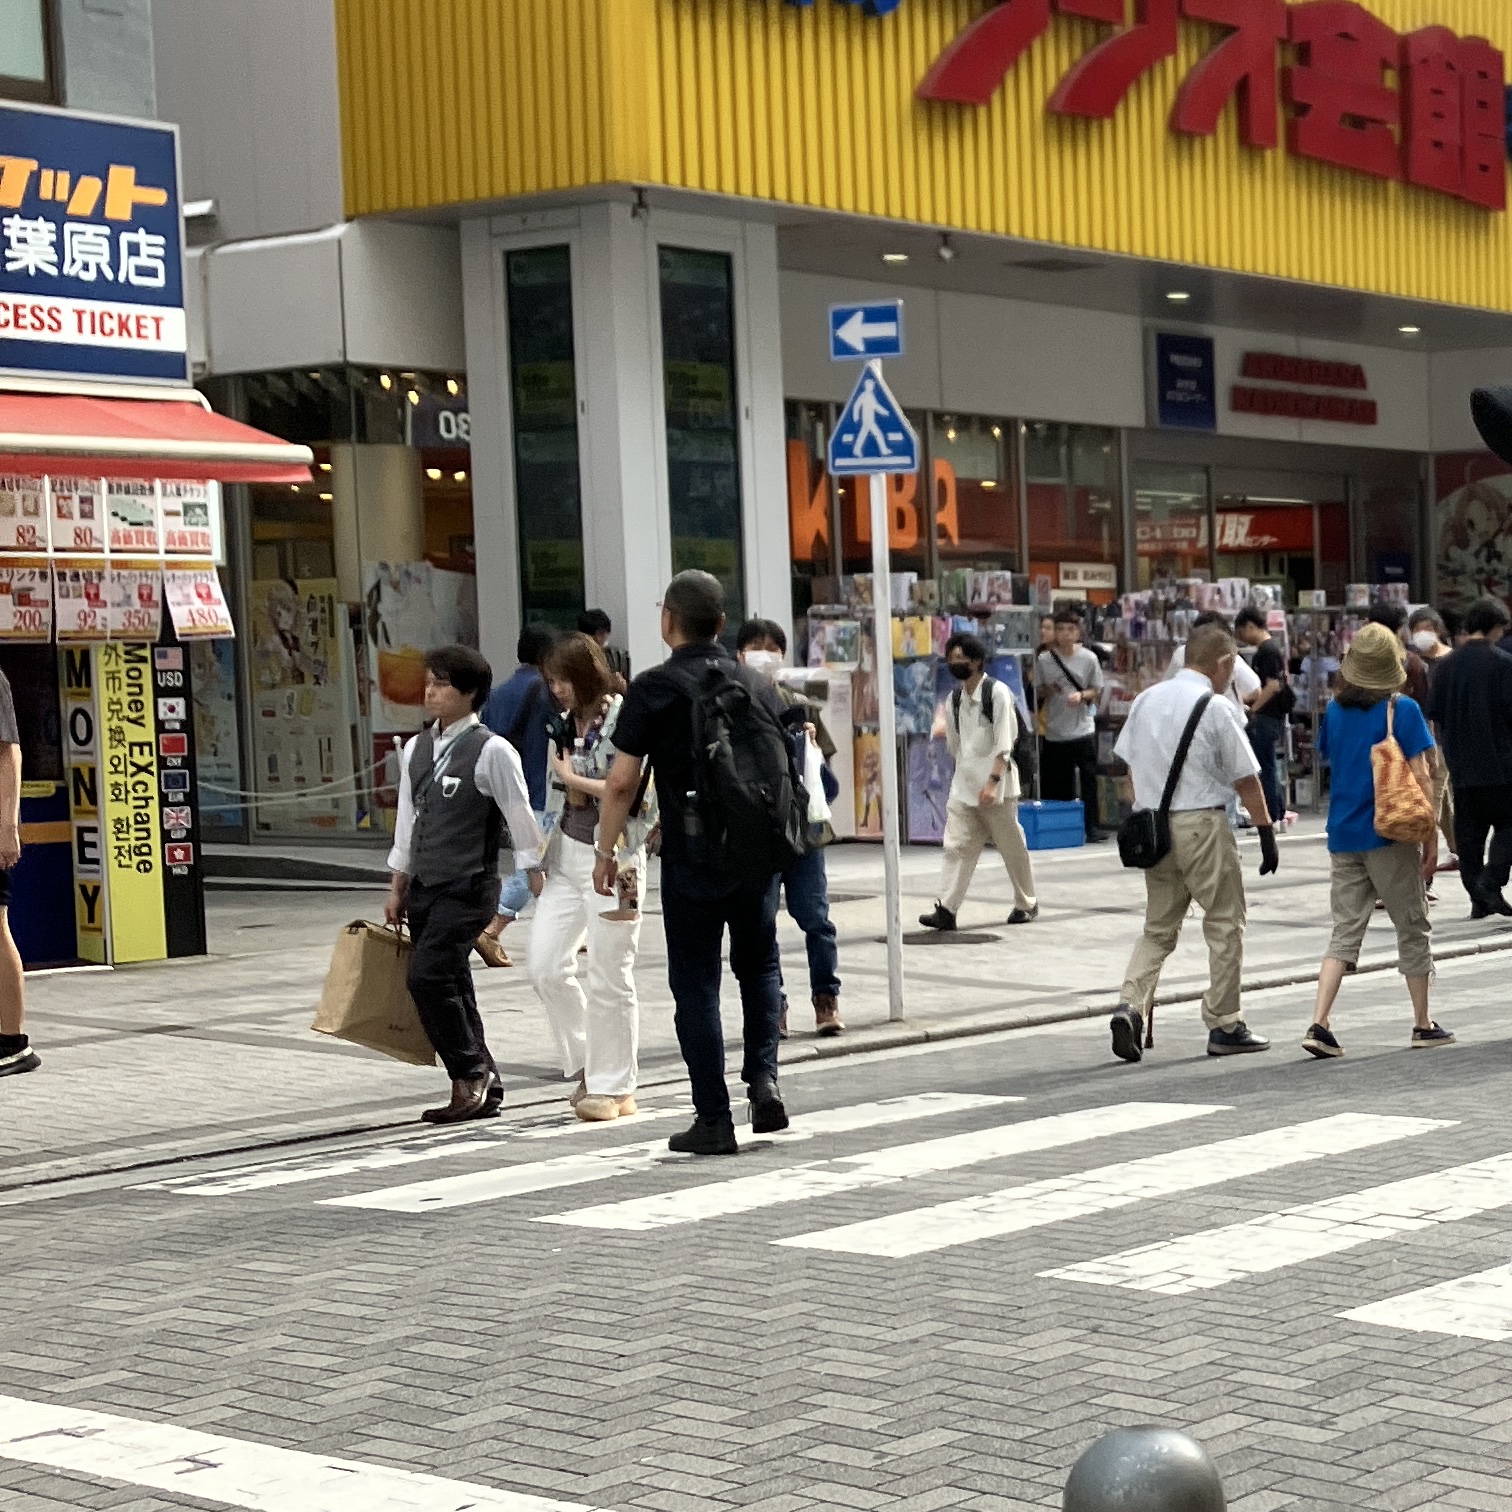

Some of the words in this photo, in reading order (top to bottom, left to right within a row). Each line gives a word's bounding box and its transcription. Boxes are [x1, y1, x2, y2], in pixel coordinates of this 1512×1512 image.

[2, 213, 166, 288] 葉原店
[72, 307, 165, 341] TICKET
[122, 642, 149, 728] Money
[157, 671, 183, 688] USD
